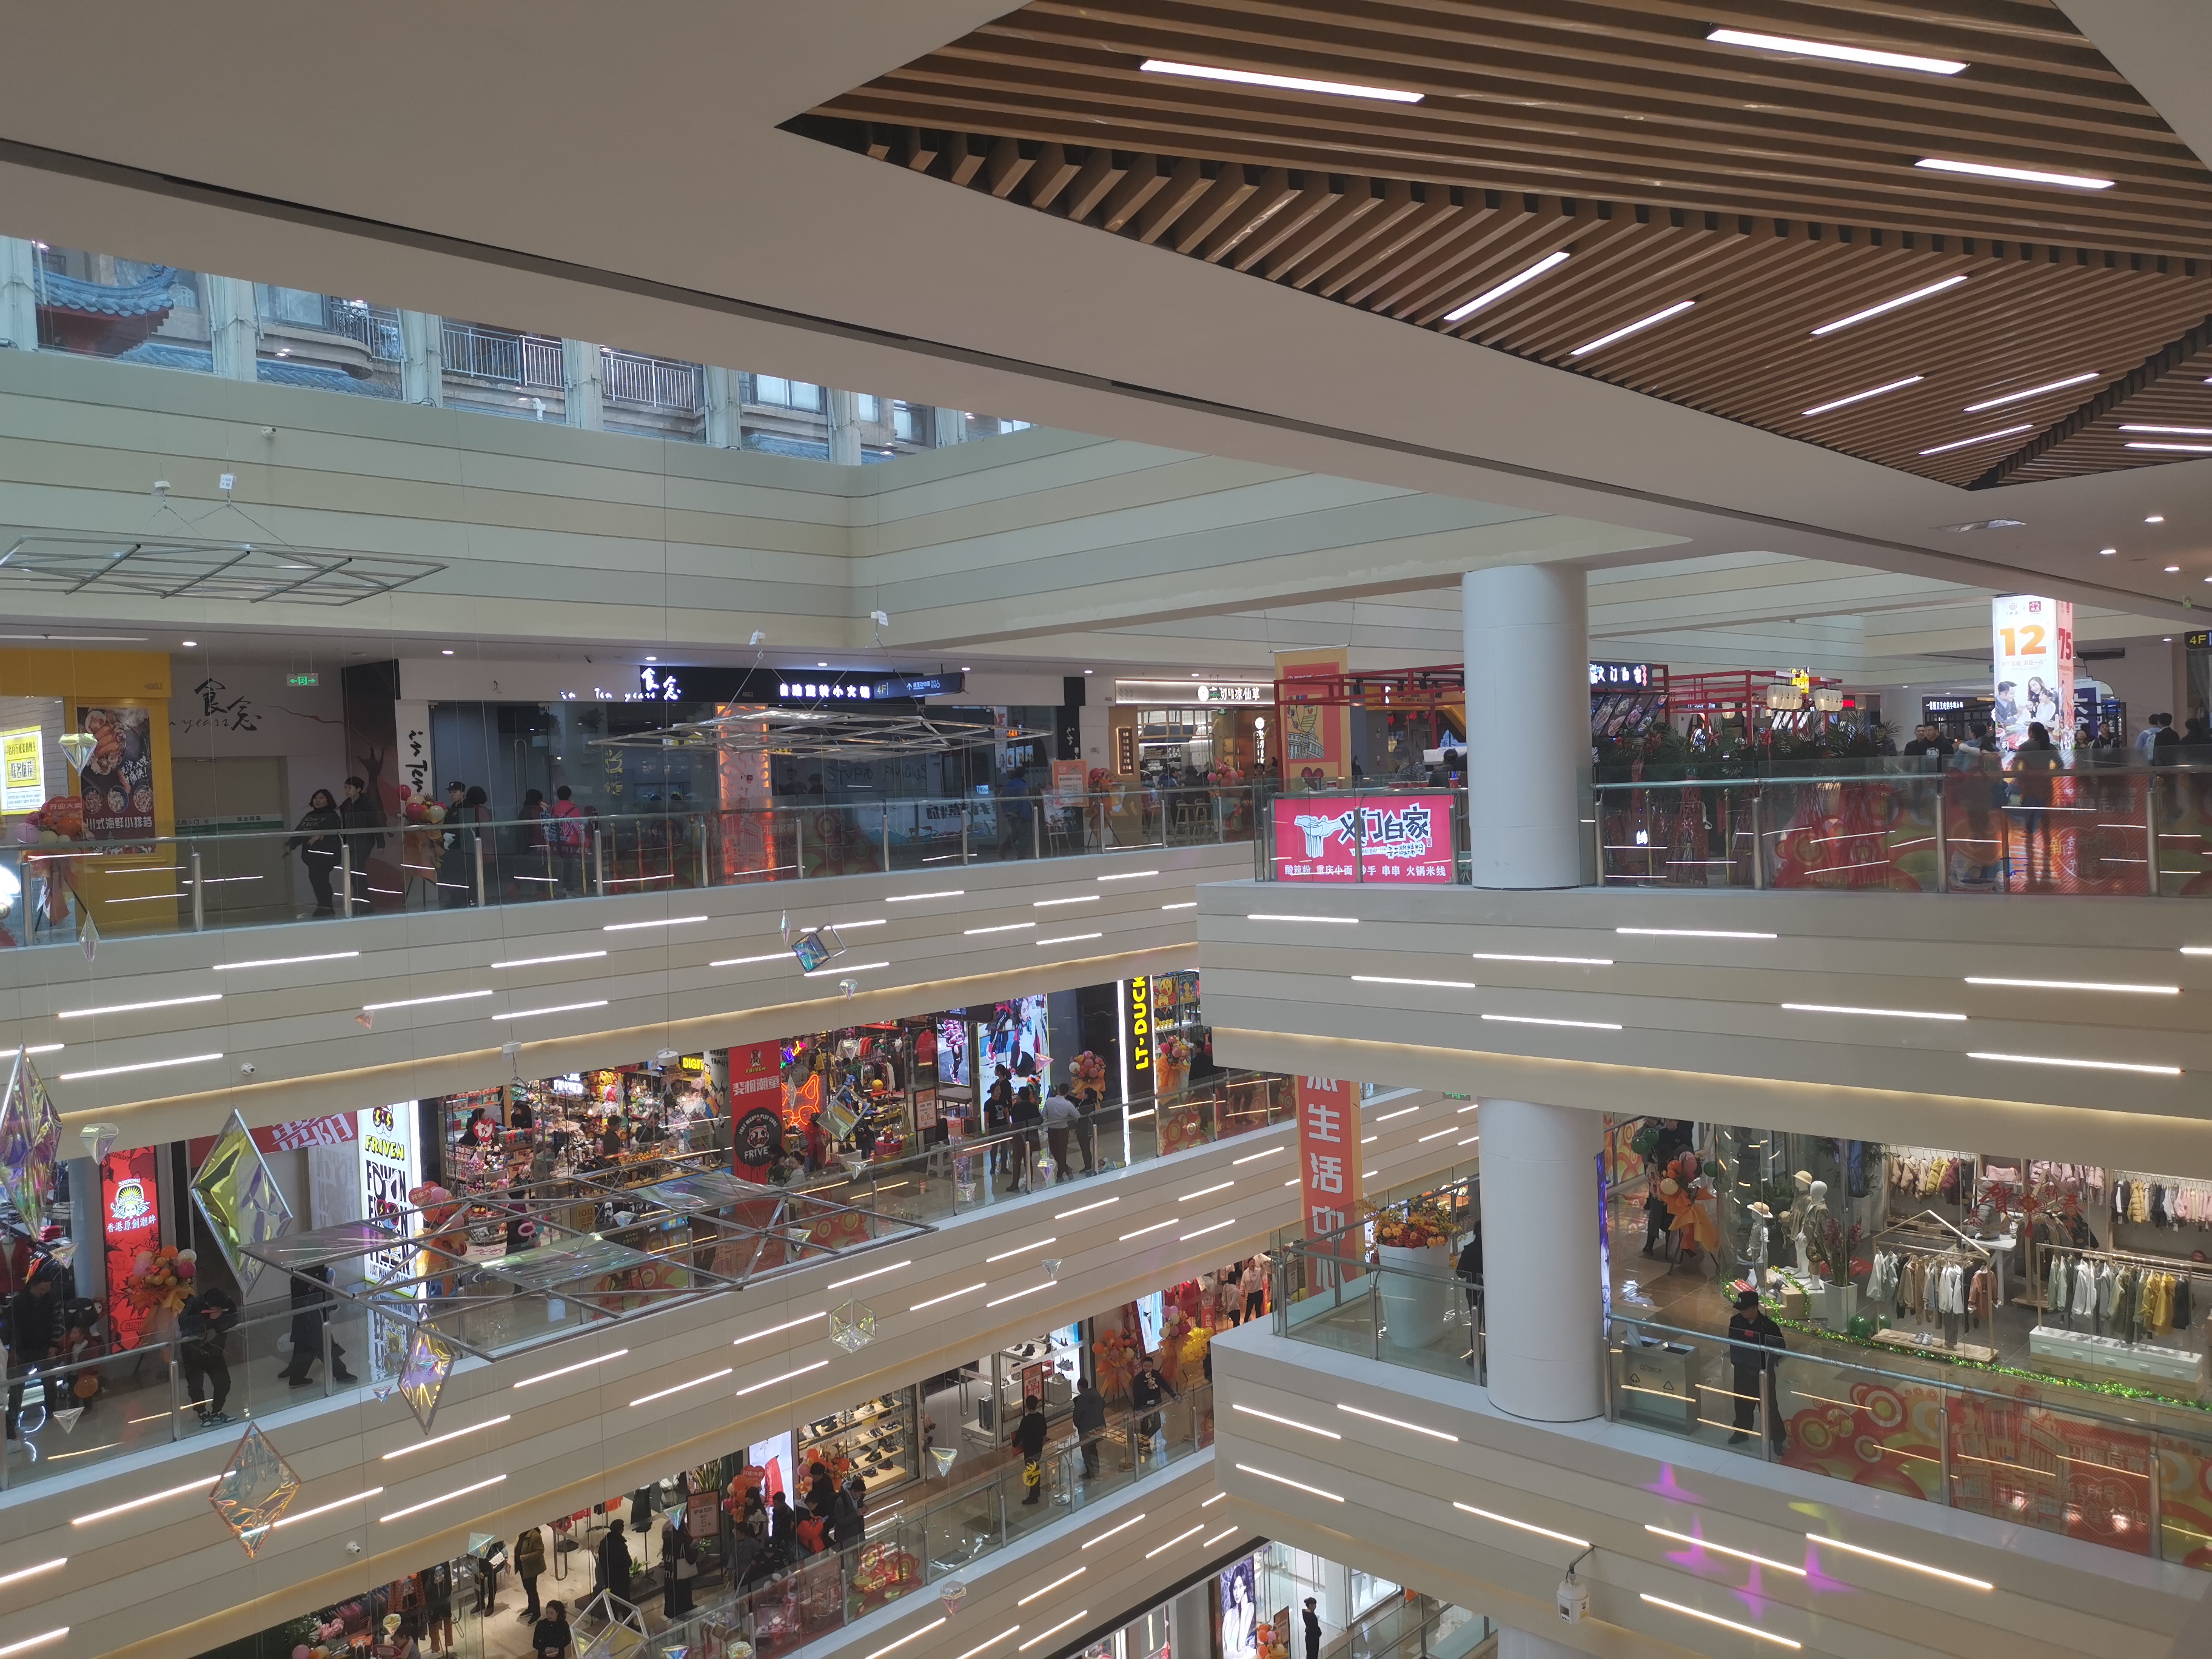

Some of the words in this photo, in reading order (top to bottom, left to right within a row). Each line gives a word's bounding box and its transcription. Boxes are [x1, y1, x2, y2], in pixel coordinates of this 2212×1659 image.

[2190, 634, 2207, 645] 4F
[1284, 865, 1310, 875] 酸辣粉
[1316, 865, 1353, 876] 重庆小面
[1382, 865, 1401, 876] 串串
[1406, 865, 1446, 877] 火锅米线
[745, 1065, 766, 1075] FRIVEN
[365, 1134, 405, 1161] FRIVEN
[744, 1145, 771, 1161] FRIVE
[118, 1178, 141, 1187] SHINING
[107, 1214, 156, 1233] 香港原創潮牌
